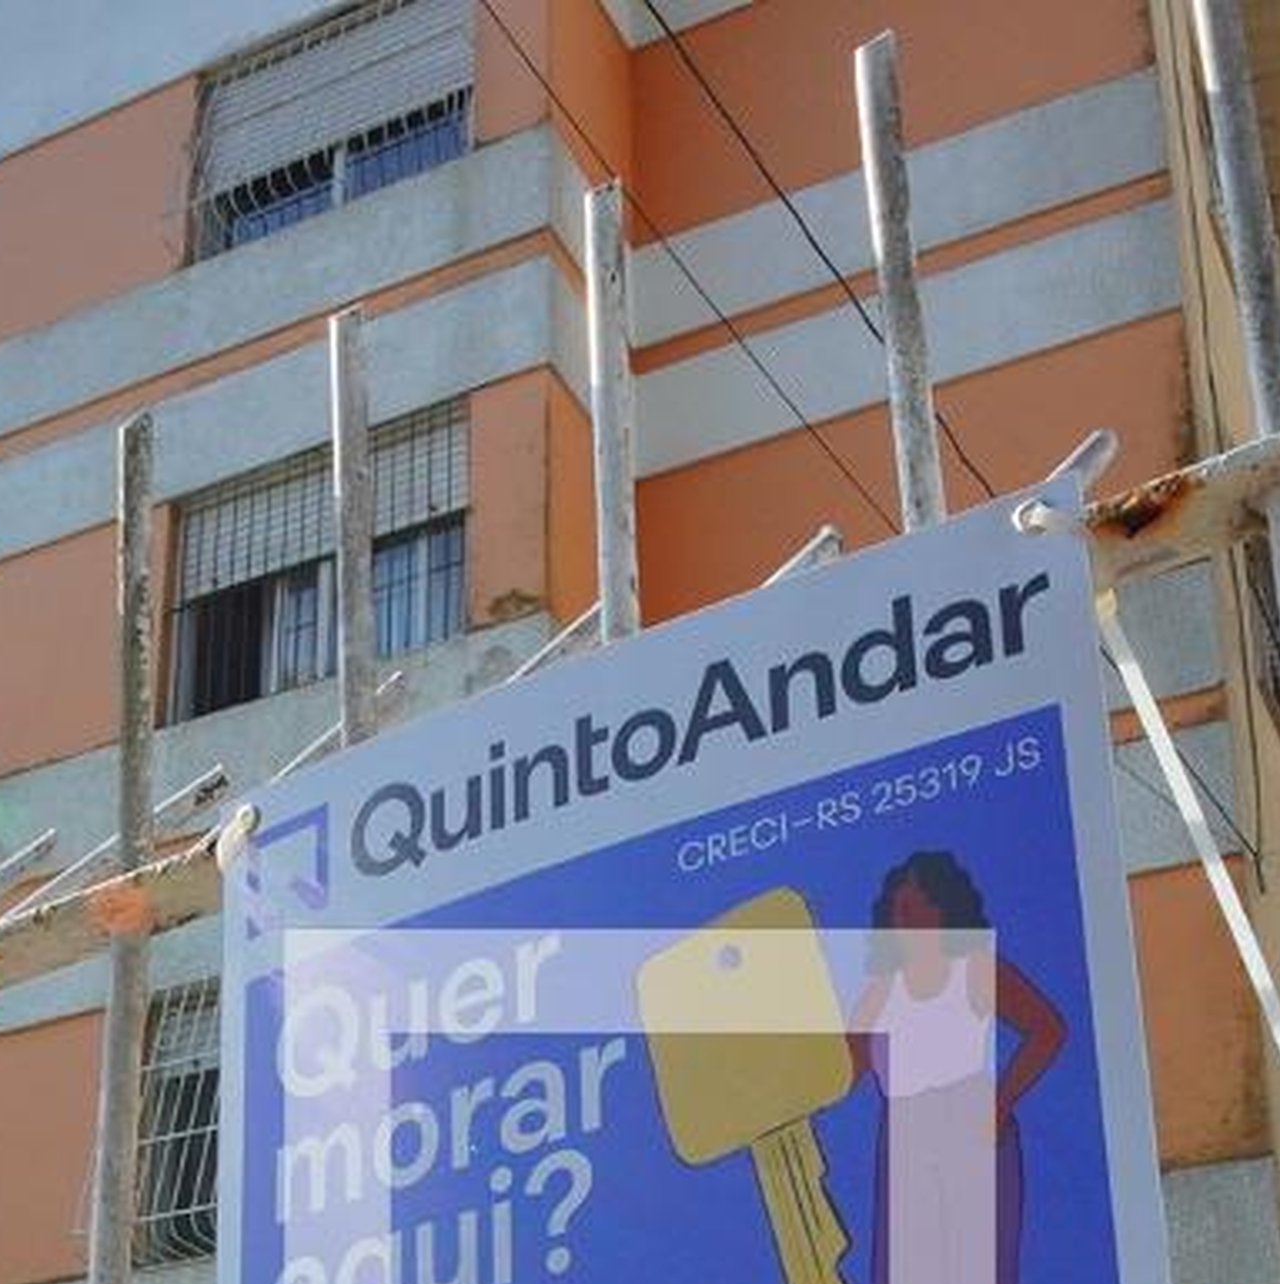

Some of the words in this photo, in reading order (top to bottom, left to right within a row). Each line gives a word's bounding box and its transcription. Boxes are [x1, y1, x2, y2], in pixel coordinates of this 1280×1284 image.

[350, 571, 1051, 880] QuintoAndar
[874, 753, 983, 815] 25319
[994, 737, 1042, 778] JS
[276, 934, 562, 1098] Quer
[276, 1038, 626, 1225] morar
